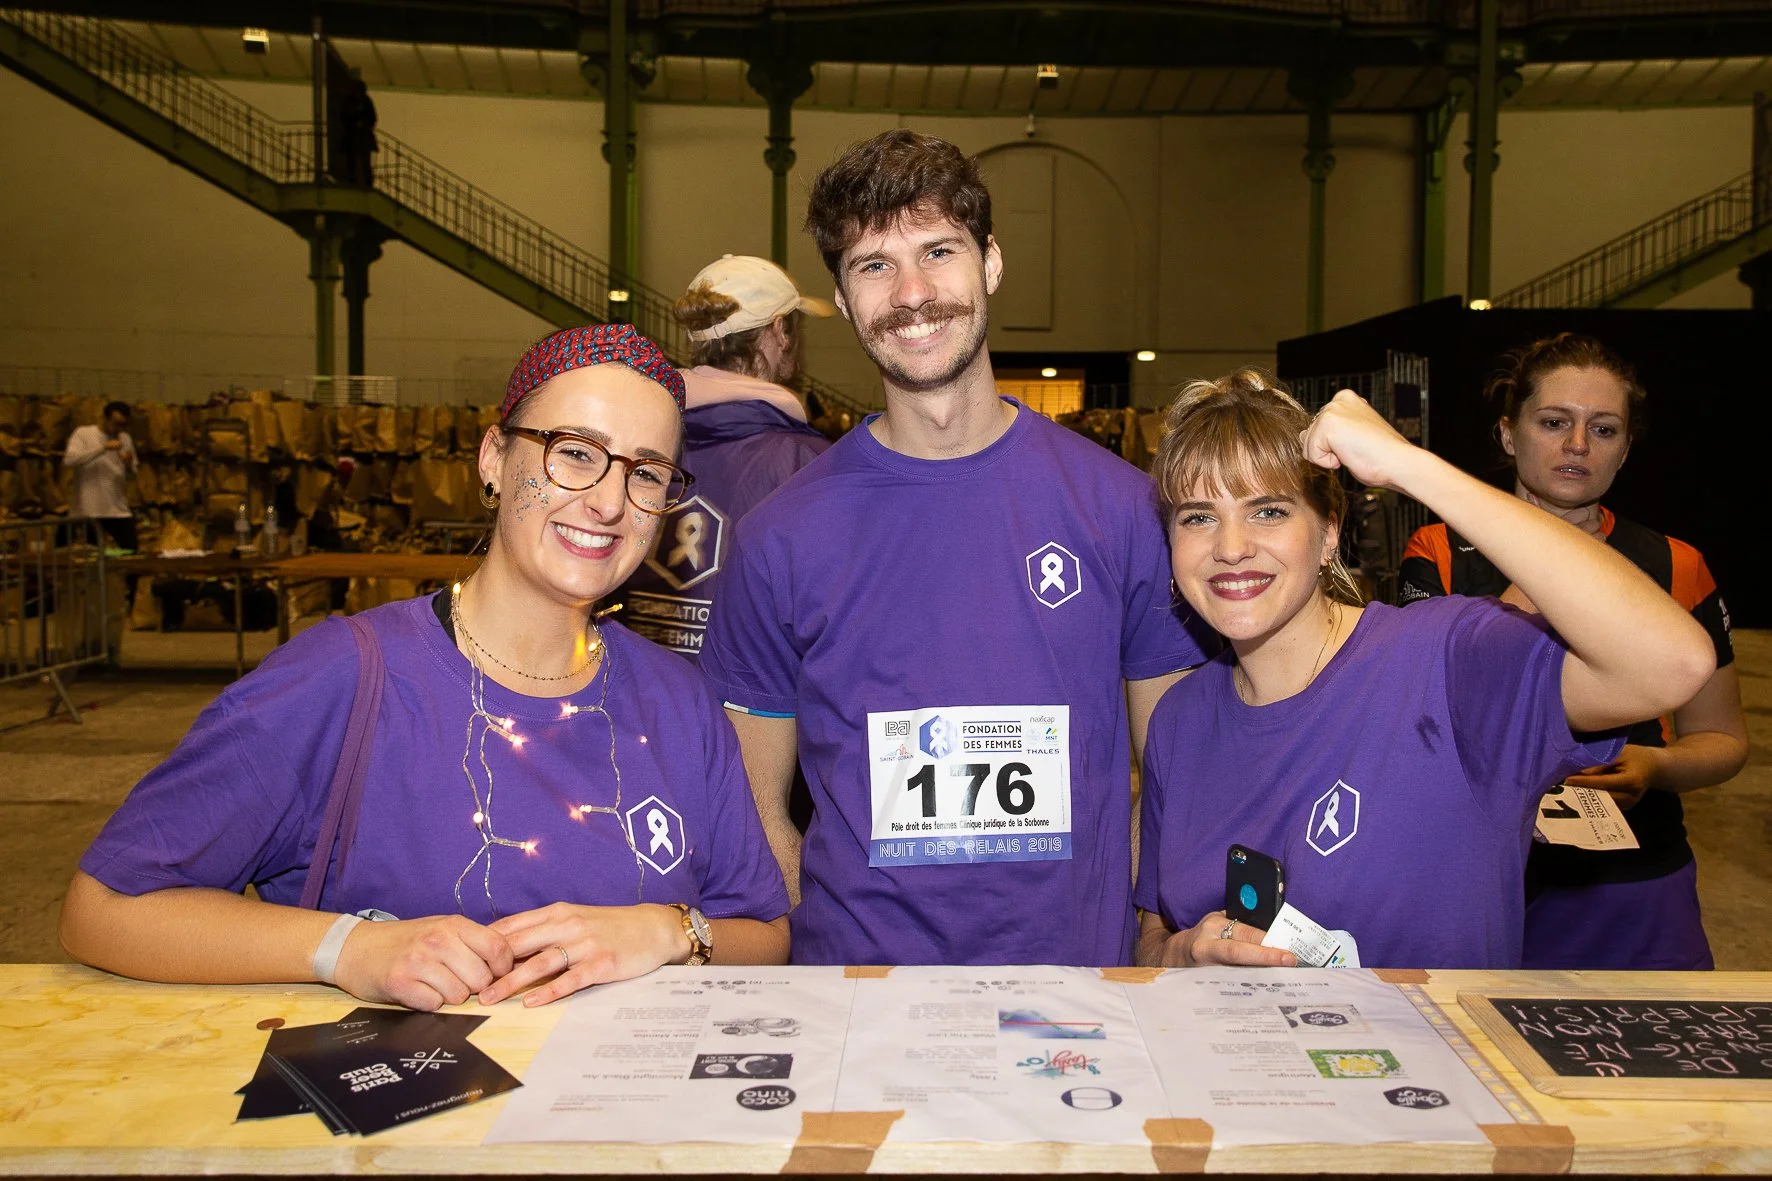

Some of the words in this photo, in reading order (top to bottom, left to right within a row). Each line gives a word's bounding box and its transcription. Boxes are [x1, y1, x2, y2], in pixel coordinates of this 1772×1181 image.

[963, 725, 1022, 734] FONDATION
[963, 741, 981, 749] DES
[985, 740, 1022, 749] FEMMES
[908, 762, 1035, 817] 176
[1541, 800, 1581, 819] 1
[1578, 792, 1596, 818] FEMMES
[906, 822, 919, 830] droit
[922, 822, 932, 830] des
[934, 821, 957, 830] femmes
[983, 818, 1006, 829] juridique
[1009, 818, 1015, 827] de
[1017, 818, 1022, 827] la
[1024, 818, 1049, 827] Sorbonne
[879, 843, 916, 857] NUIT
[924, 841, 956, 856] DES
[965, 839, 1021, 855] RELAIS
[1028, 837, 1062, 852] 2019
[1518, 1021, 1623, 1039] NON
[339, 1062, 388, 1080] Club
[1677, 1056, 1740, 1074] DE
[348, 1067, 394, 1085] Beer
[350, 1073, 402, 1093] Paris
